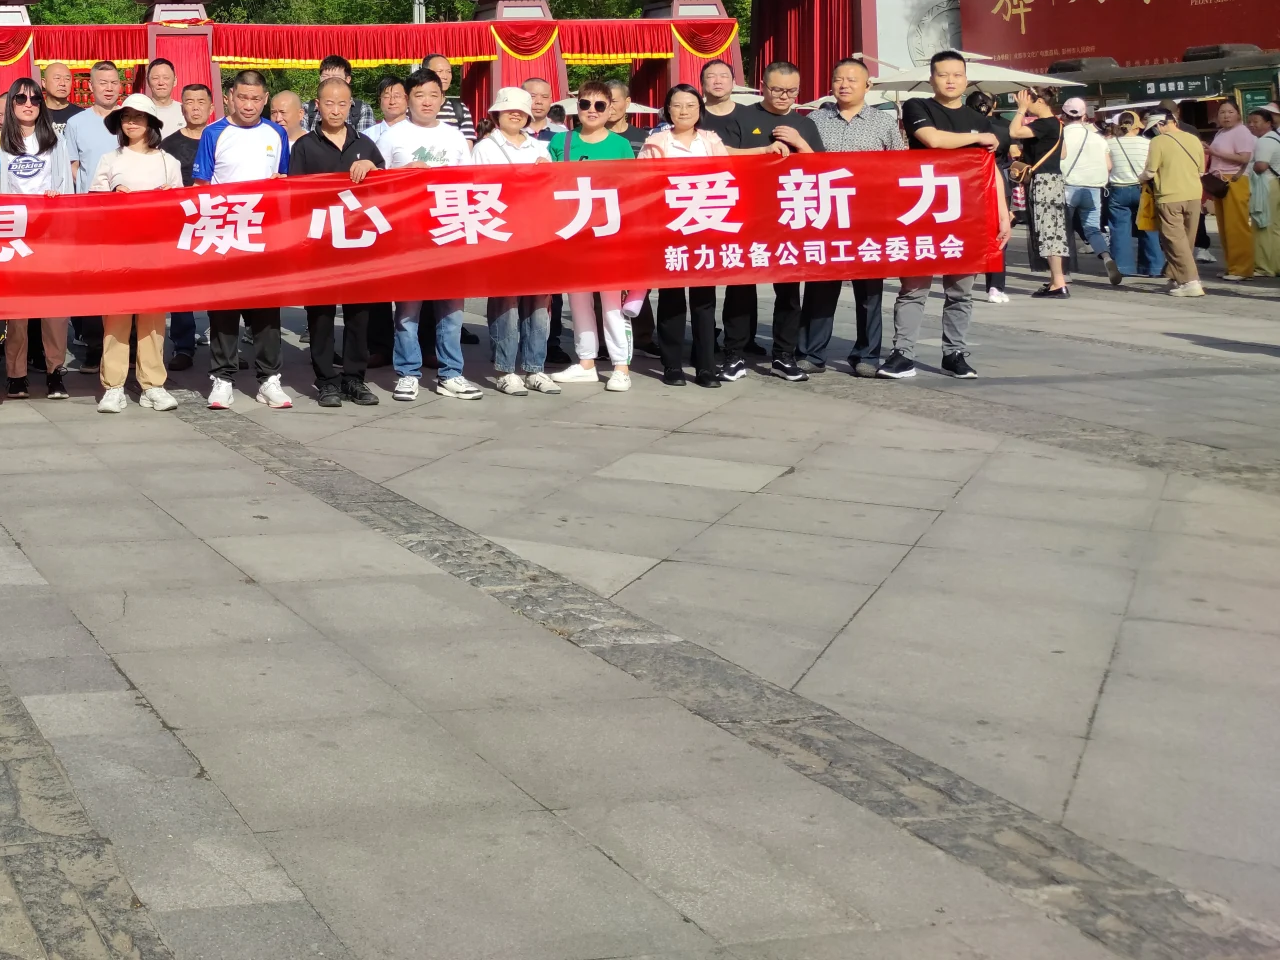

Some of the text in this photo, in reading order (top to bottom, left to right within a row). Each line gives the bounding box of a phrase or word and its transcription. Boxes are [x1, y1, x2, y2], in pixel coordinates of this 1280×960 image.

[10, 161, 44, 170] Dickies
[178, 164, 962, 256] 凝心聚力爱新力
[664, 234, 964, 272] 新力设备公司工会委员会
